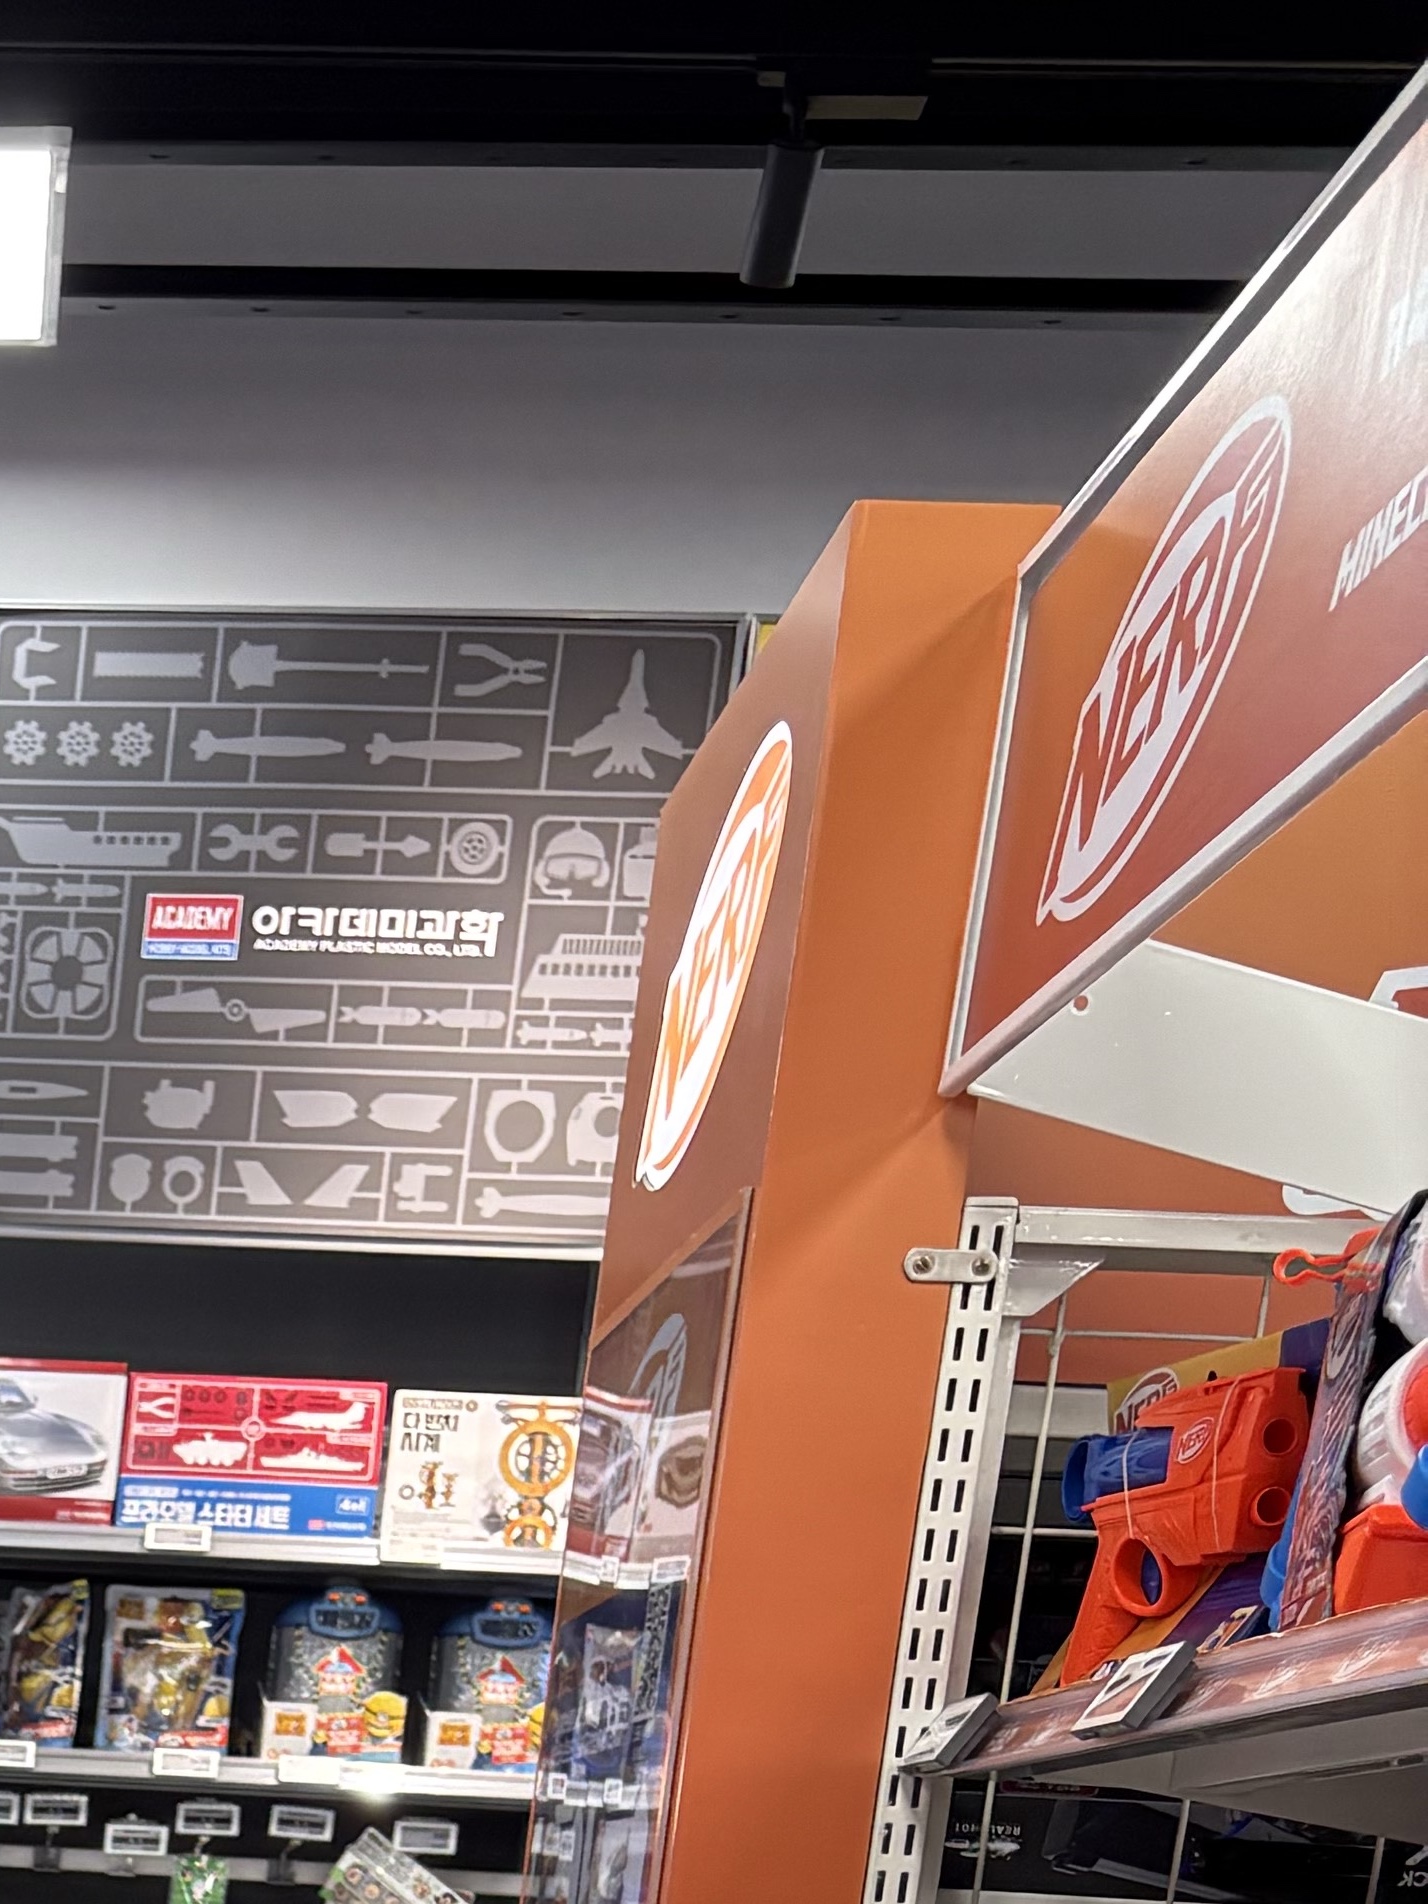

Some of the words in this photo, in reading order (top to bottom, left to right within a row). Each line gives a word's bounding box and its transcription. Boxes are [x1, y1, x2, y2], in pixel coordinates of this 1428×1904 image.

[1041, 415, 1286, 915] NERF
[152, 904, 235, 930] ACADEMY
[252, 905, 504, 957] 아카데미과학
